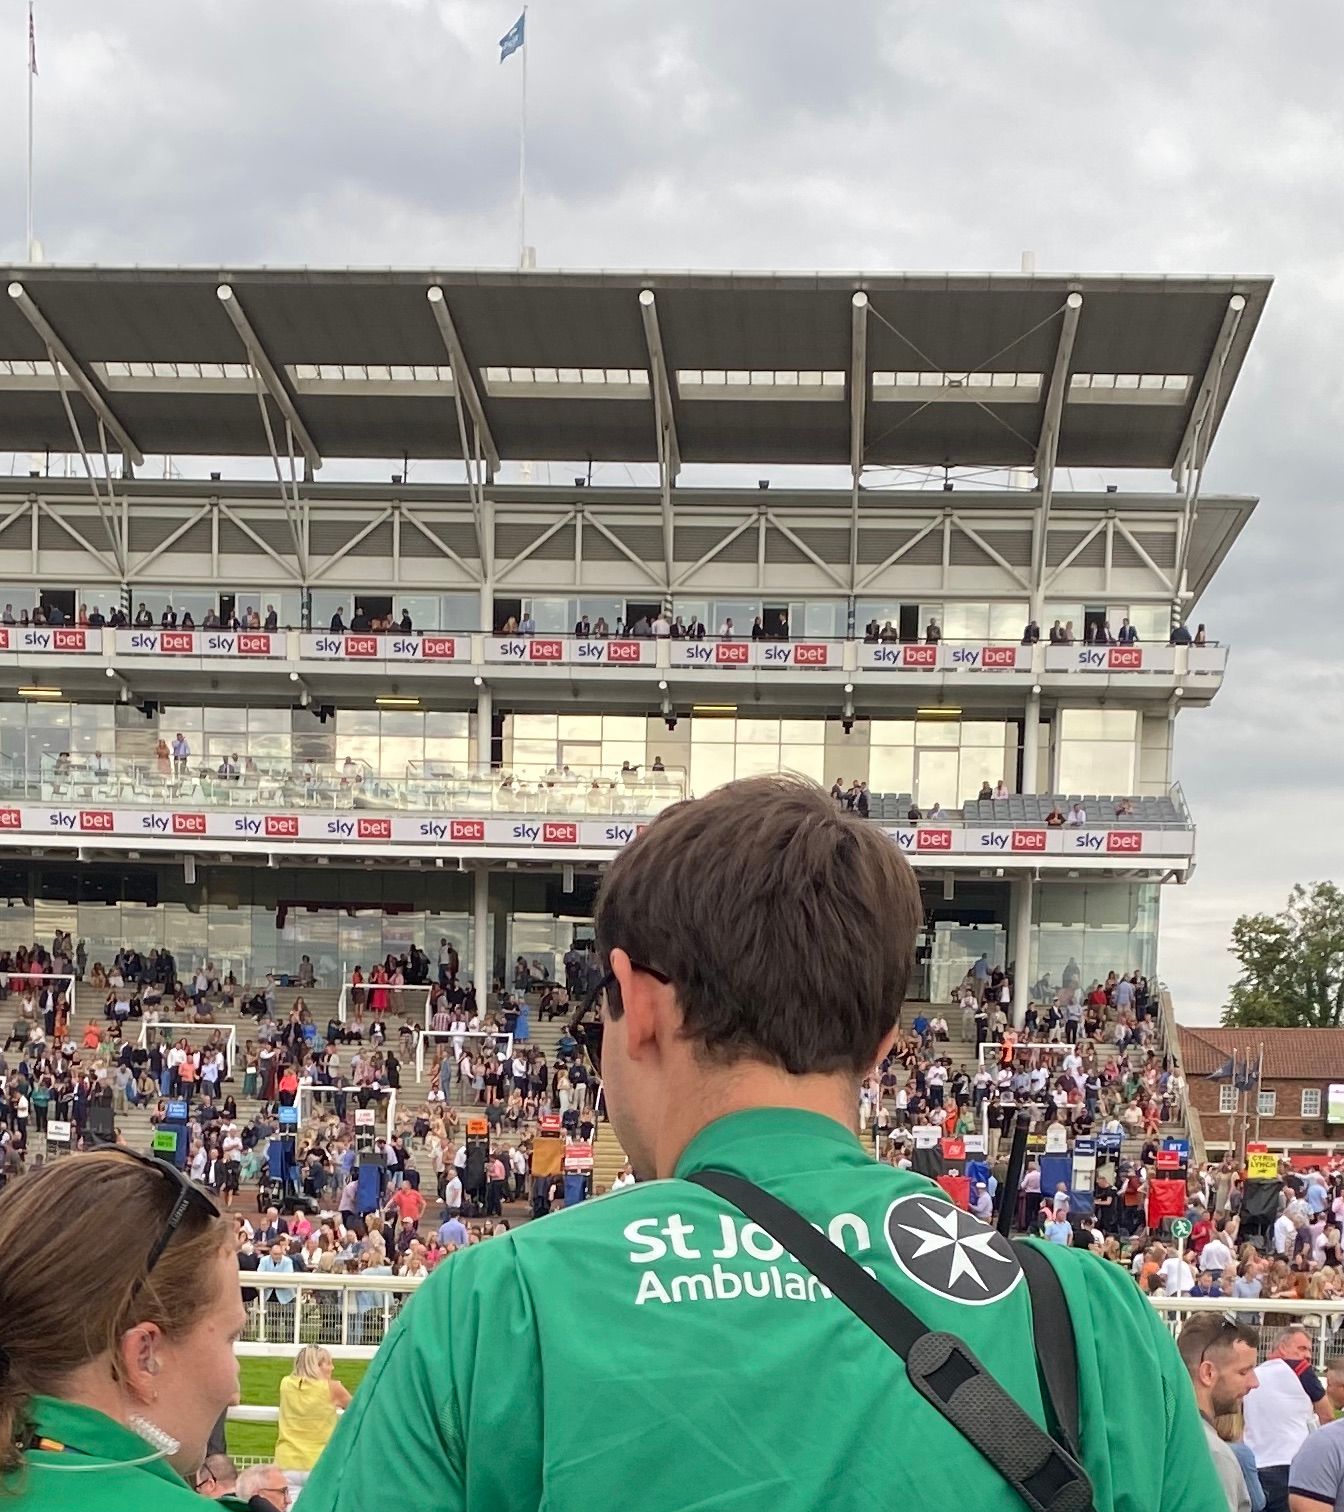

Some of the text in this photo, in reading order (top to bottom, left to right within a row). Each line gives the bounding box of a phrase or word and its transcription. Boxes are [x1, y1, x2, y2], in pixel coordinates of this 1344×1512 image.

[25, 632, 83, 648] sky bet
[132, 634, 190, 650] sky bet
[209, 635, 267, 652] sky bet
[316, 638, 375, 654] sky bet
[394, 639, 452, 656] sky bet
[501, 642, 559, 658] sky bet
[579, 643, 638, 660] sky bet
[687, 645, 746, 662] sky bet
[765, 646, 824, 662] sky bet
[874, 647, 933, 664] sky bet
[952, 648, 1013, 666] sky bet
[1079, 648, 1139, 667] sky bet
[50, 812, 111, 829] sky bet
[143, 814, 204, 831] sky bet
[235, 817, 296, 834] sky bet
[328, 820, 388, 836] sky bet
[421, 822, 481, 838] sky bet
[513, 824, 574, 841] sky bet
[606, 826, 632, 843] sky
[920, 831, 949, 846] bet
[982, 832, 1044, 849] sky bet
[1076, 833, 1139, 850] sky bet
[623, 1212, 871, 1263] St Jon
[634, 1263, 878, 1305] Ambulan
